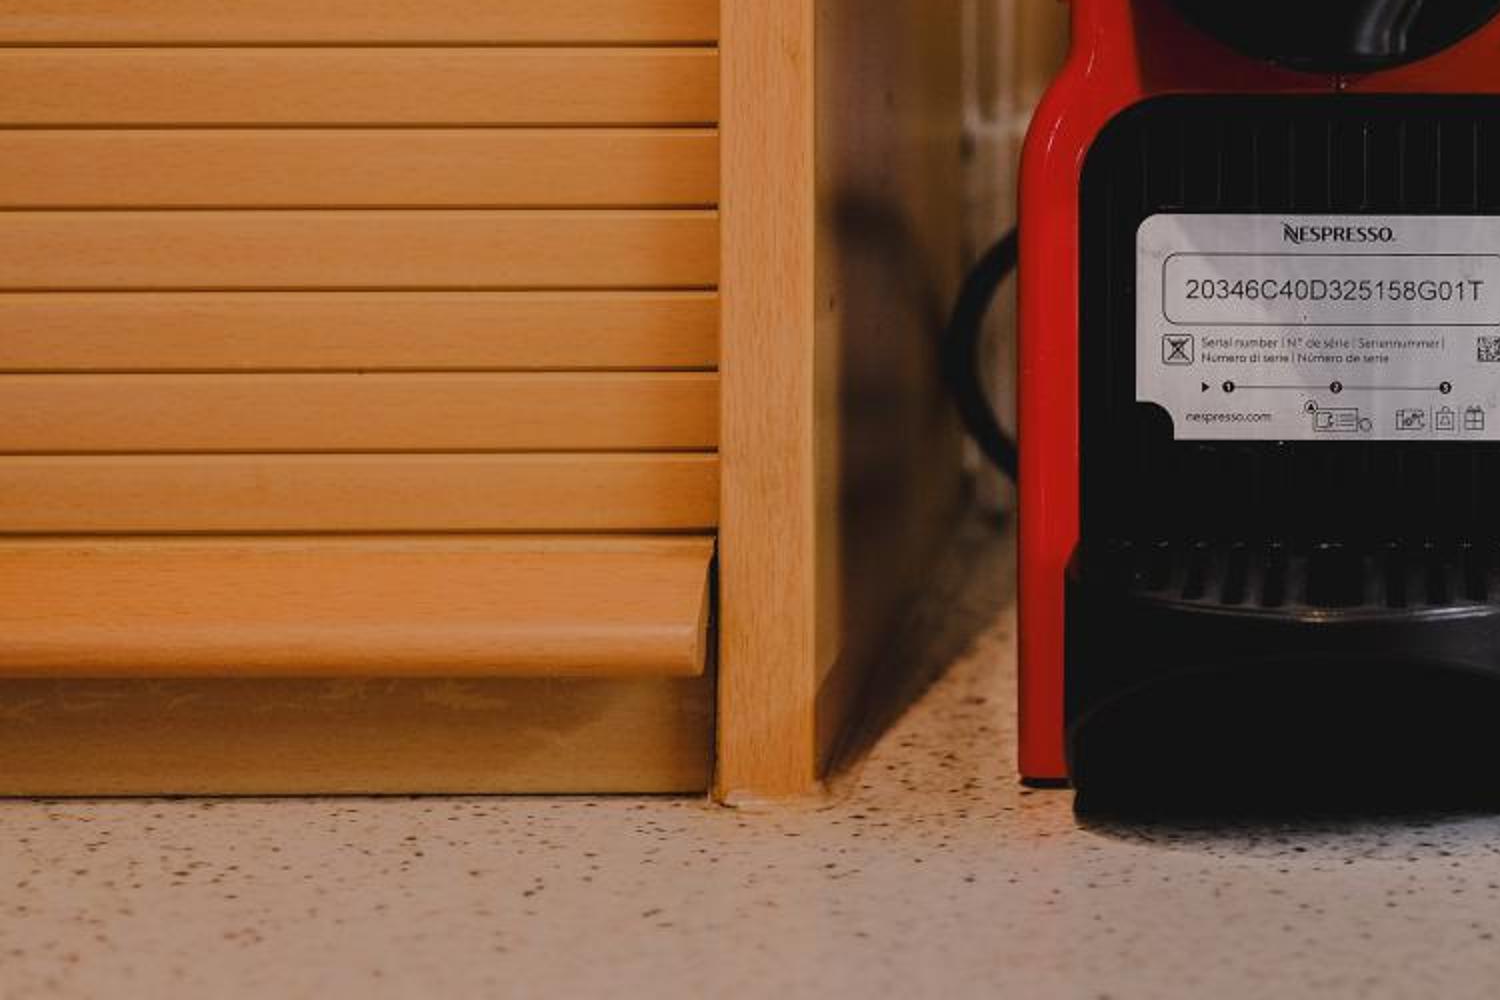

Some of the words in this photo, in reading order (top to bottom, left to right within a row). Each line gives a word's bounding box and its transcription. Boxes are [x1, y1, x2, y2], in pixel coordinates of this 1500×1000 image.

[1284, 223, 1392, 244] NESPRESSO
[1185, 279, 1485, 302] 20346C40D325158G01T
[1201, 336, 1232, 348] Serial
[1234, 336, 1278, 348] number
[1185, 410, 1272, 424] nespresso.com
